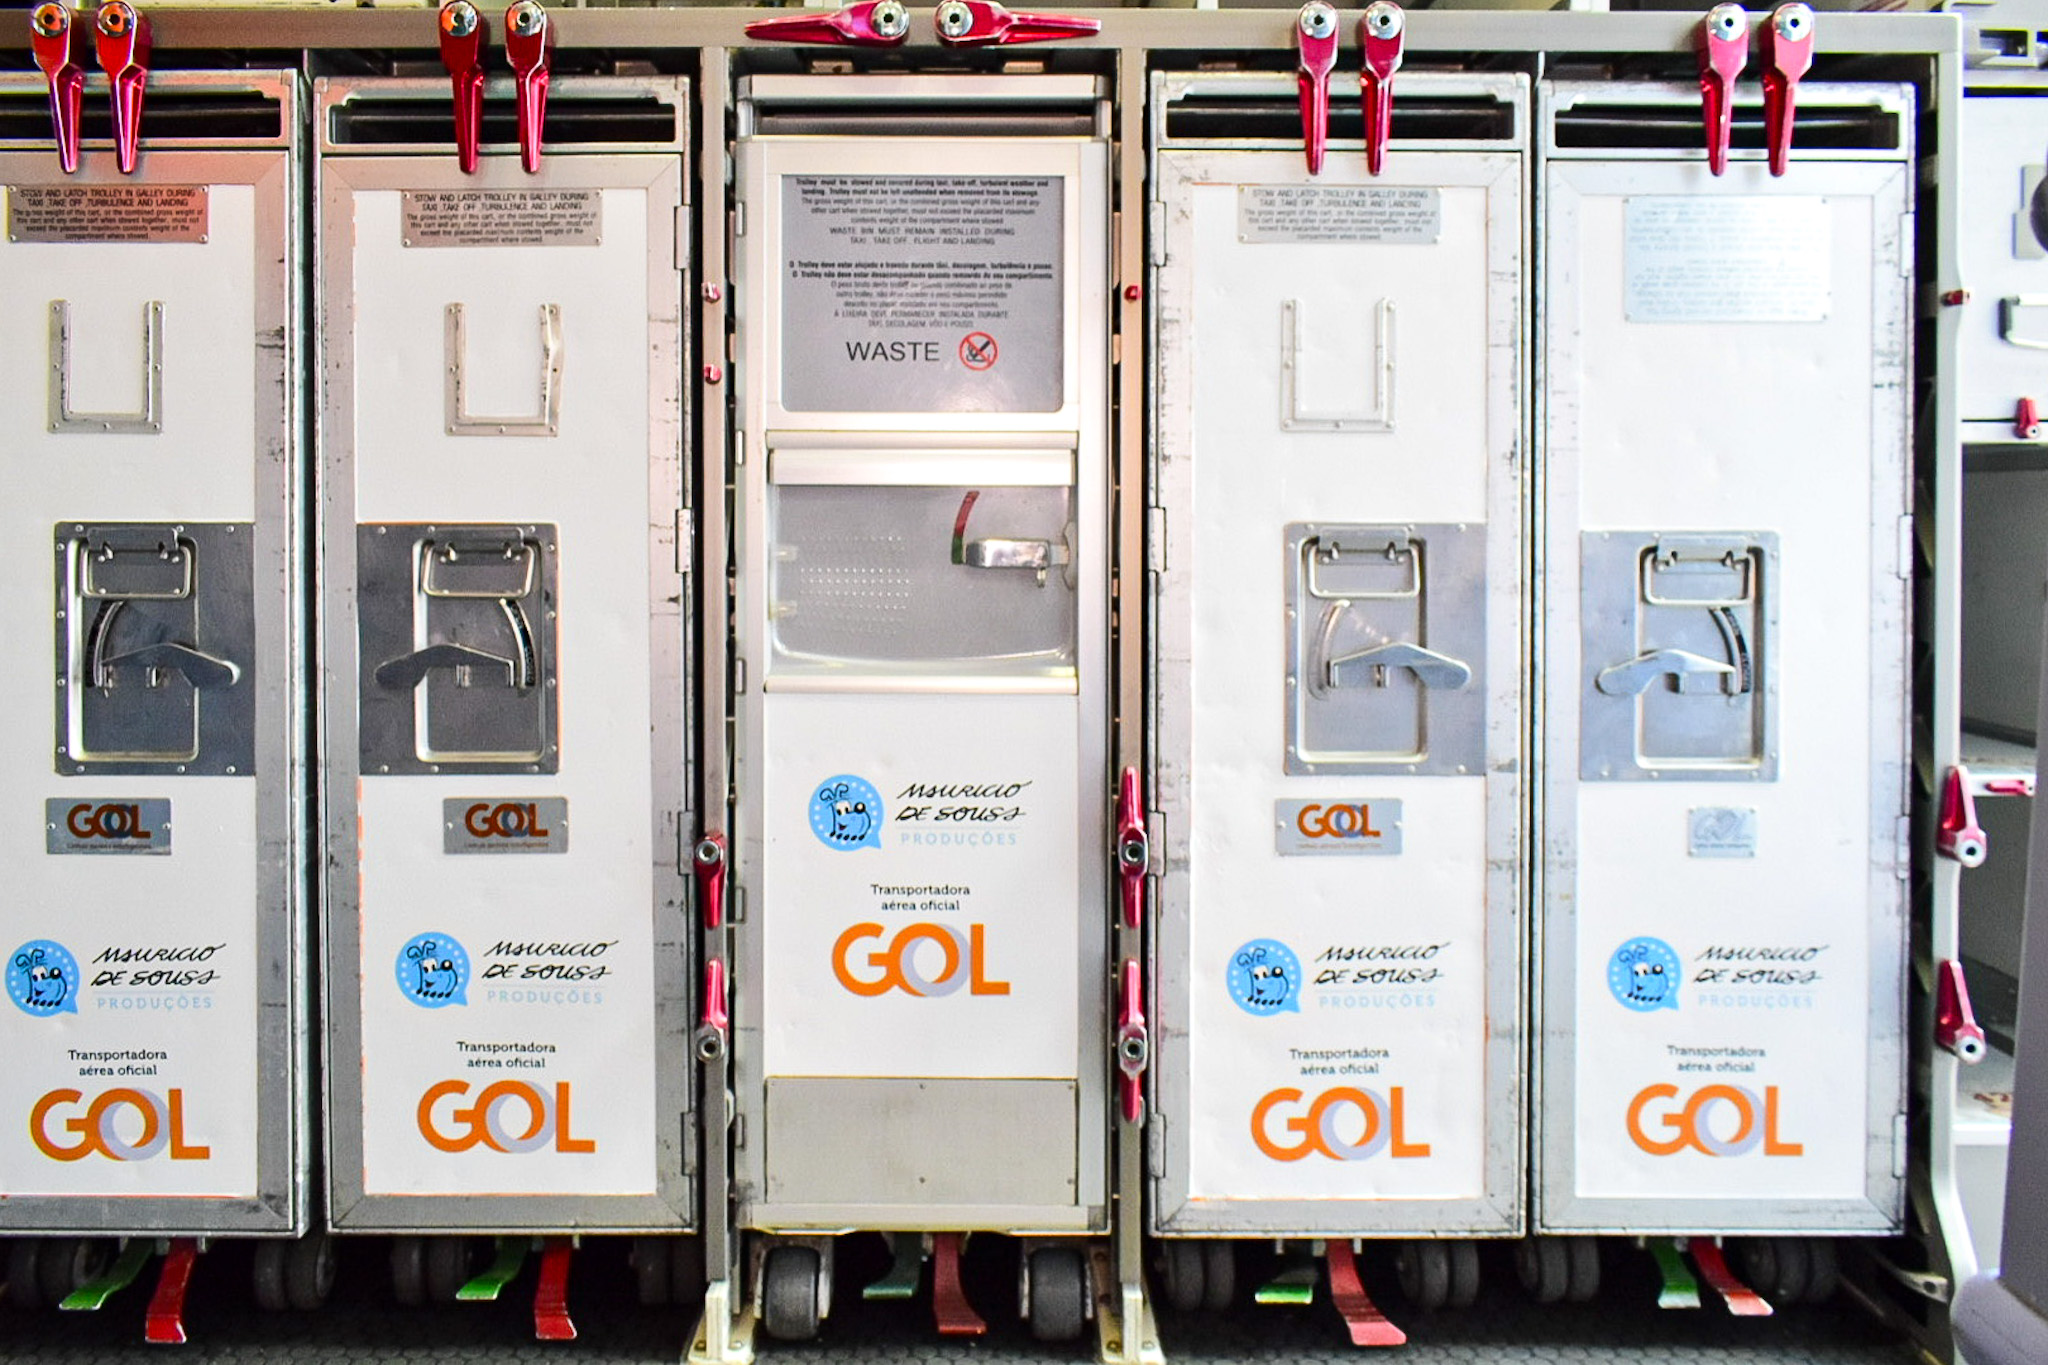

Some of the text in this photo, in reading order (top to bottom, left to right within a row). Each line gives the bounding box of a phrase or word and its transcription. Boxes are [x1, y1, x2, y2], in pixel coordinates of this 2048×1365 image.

[20, 188, 196, 198] STOW AND LATCH TROLLEY IN GALLEY DURING
[415, 192, 589, 202] STOW AND LATCH TROLLEY IN GALLEY DURING
[846, 341, 939, 362] WASTE
[896, 780, 1033, 800] MAURICIO
[67, 804, 151, 839] GOL
[465, 803, 548, 839] GOL
[895, 805, 1027, 822] DE SOUSA
[1297, 804, 1381, 839] GOL
[901, 831, 1017, 847] PRODUÇÕES
[871, 883, 970, 898] Transportadora
[881, 899, 960, 911] aérea oficial
[92, 943, 227, 964] MAURICIO
[483, 940, 619, 958] MAURICIO
[1315, 941, 1451, 963] MAURICIO
[1694, 944, 1830, 962] MAURICIO
[832, 922, 1010, 997] GOL
[90, 970, 221, 987] DE SOUSA
[482, 964, 613, 980] DE SOUSA
[1313, 967, 1445, 985] DE SOUSA
[1693, 967, 1823, 985] DE SOUSA
[97, 995, 213, 1012] PRODUÇÕES
[487, 989, 604, 1005] PRODUÇÕES
[1319, 992, 1436, 1010] PRODUÇÕES
[68, 1050, 168, 1064] Transportadora
[456, 1041, 556, 1056] Transportadora
[1289, 1048, 1390, 1062] Transportadora
[1667, 1045, 1766, 1059] Transportadora
[79, 1064, 157, 1077] aérea oficial
[467, 1056, 545, 1069] aérea oficial
[1300, 1062, 1379, 1076] aérea oficial
[1677, 1060, 1755, 1073] aérea oficial
[30, 1088, 210, 1162] GOL
[417, 1079, 596, 1154] GOL
[1251, 1086, 1431, 1162] GOL
[1626, 1083, 1803, 1157] GOL
